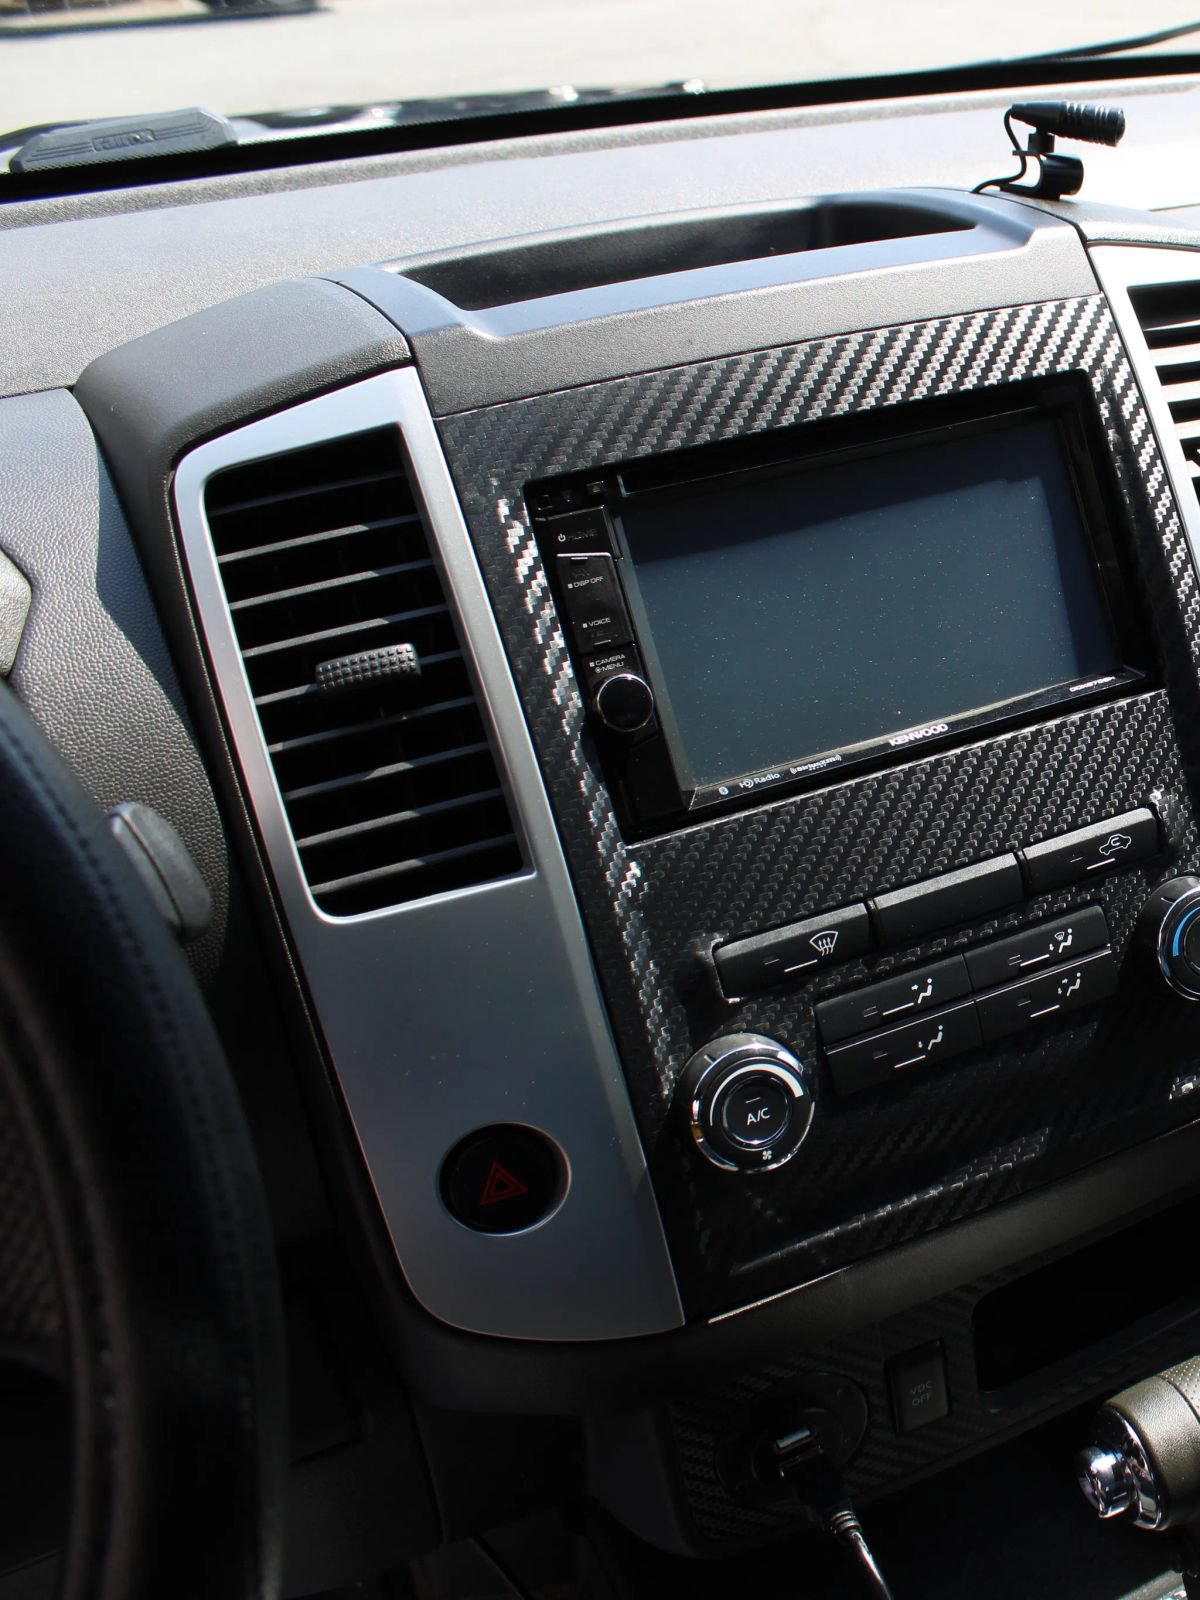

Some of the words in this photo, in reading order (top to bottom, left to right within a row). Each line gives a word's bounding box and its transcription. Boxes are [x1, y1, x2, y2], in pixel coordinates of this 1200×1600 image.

[590, 576, 604, 584] OFF
[588, 617, 611, 627] VOICE
[595, 654, 625, 666] CAMERA
[602, 661, 624, 672] MENU
[888, 723, 948, 747] KENWOOD
[755, 772, 780, 784] Radio
[746, 1107, 770, 1126] A/C
[909, 1380, 933, 1395] VDC
[911, 1392, 933, 1406] OFF
